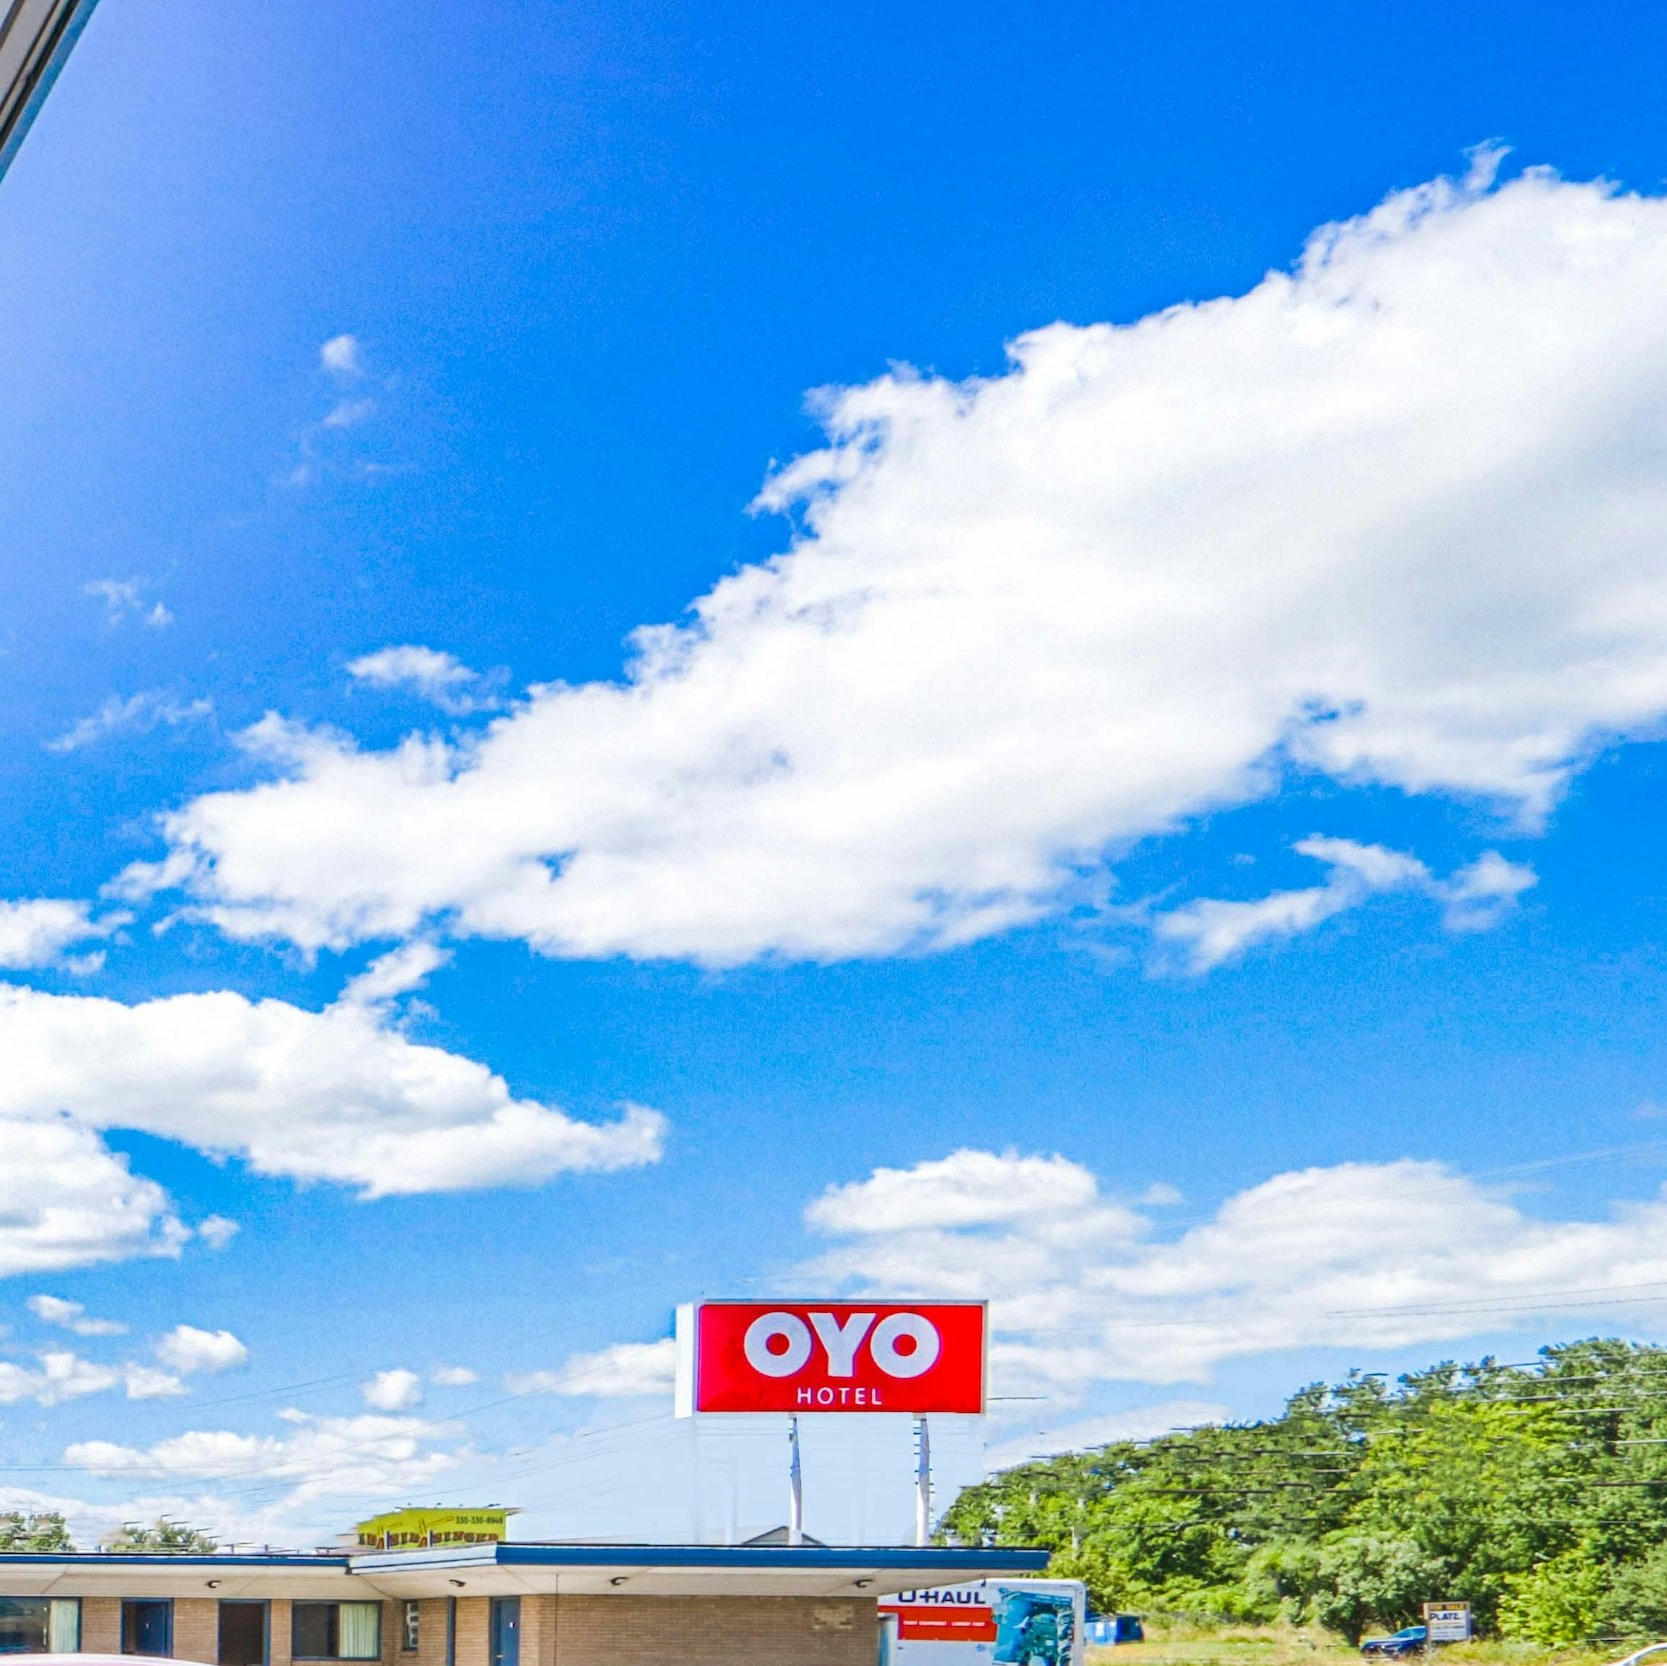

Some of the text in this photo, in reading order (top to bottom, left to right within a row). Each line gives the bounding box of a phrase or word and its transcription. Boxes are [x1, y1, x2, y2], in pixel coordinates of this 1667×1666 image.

[744, 1311, 940, 1378] OYO
[797, 1387, 882, 1406] HOTEL
[898, 1590, 986, 1604] U-HAUL
